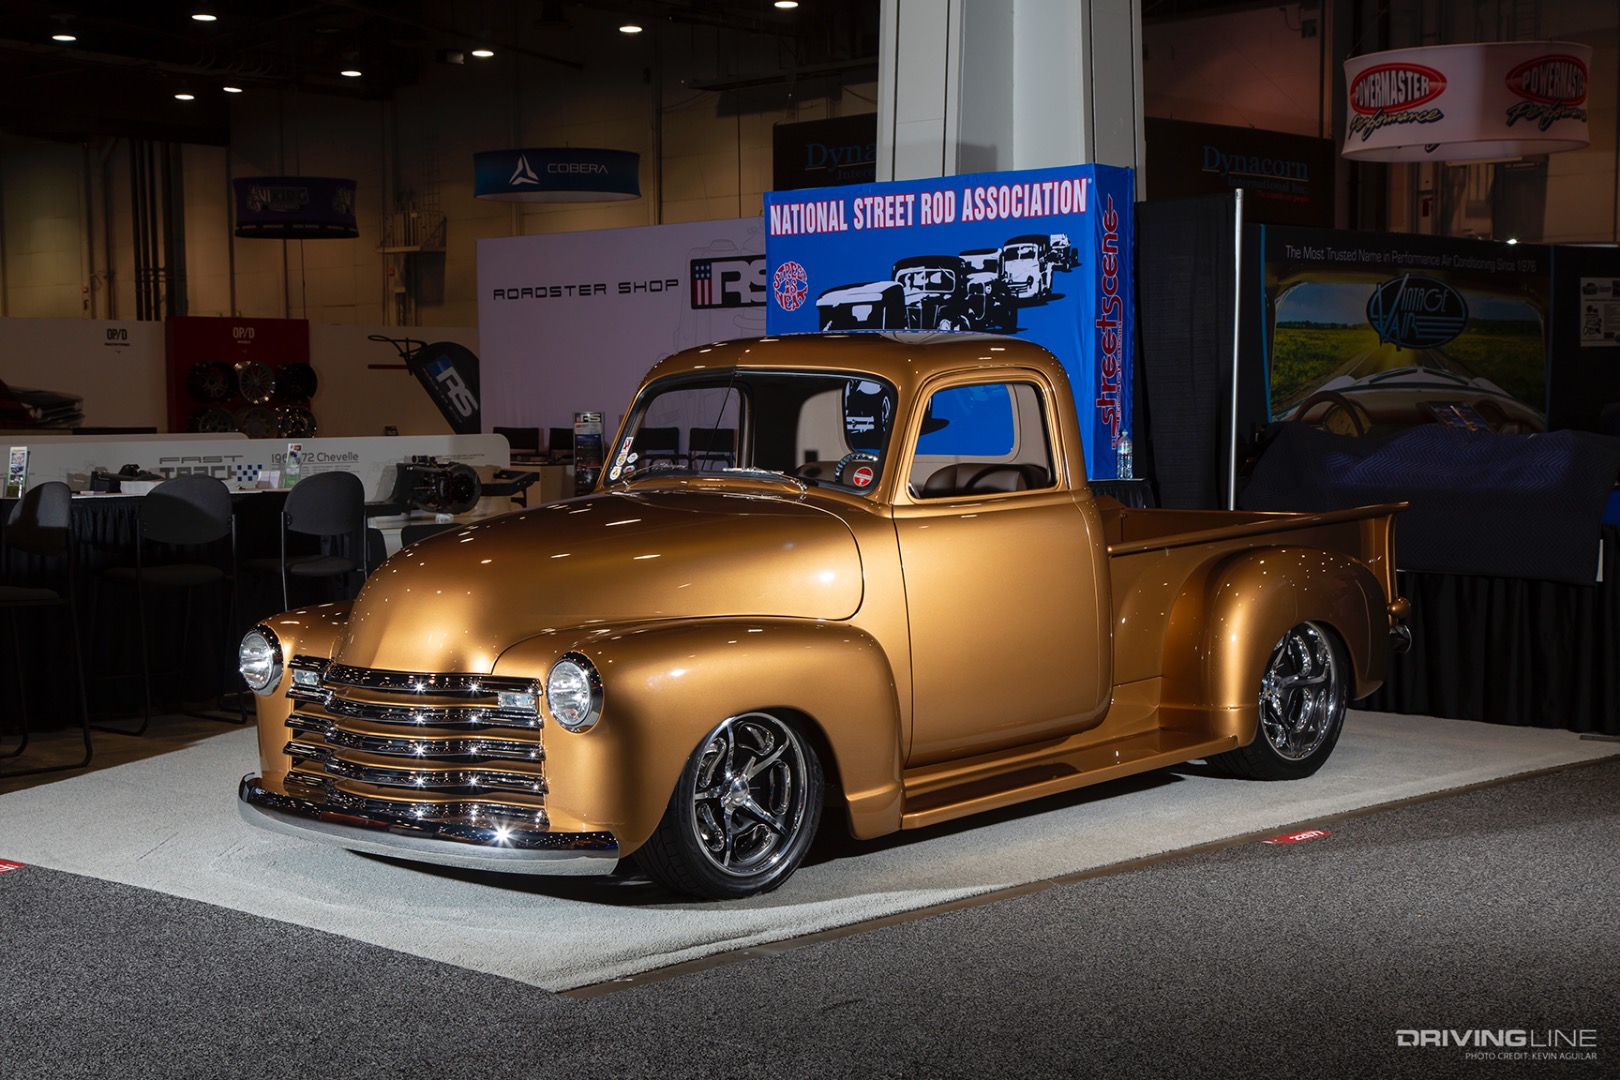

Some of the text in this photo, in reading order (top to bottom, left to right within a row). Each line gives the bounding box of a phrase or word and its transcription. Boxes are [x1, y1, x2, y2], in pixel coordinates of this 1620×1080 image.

[1348, 107, 1445, 142] Performance
[547, 163, 609, 174] COBERA
[1202, 144, 1310, 177] Dynacorn
[770, 178, 1087, 235] NATIONAL STREET ROD ASSOCIATION
[1285, 245, 1301, 259] The
[1303, 246, 1325, 260] Most
[1327, 247, 1357, 262] Trusted
[1359, 249, 1382, 263] Name
[1383, 251, 1391, 262] in
[1392, 251, 1441, 266] Performance
[1442, 255, 1452, 266] Air
[1453, 255, 1496, 272] Conditioning
[1497, 257, 1515, 271] Since
[493, 279, 679, 300] ROADSTER SHOP
[1096, 193, 1123, 437] streetscene
[106, 328, 127, 341] OP/D
[232, 327, 255, 339] OP/D
[317, 451, 359, 462] Chevelle
